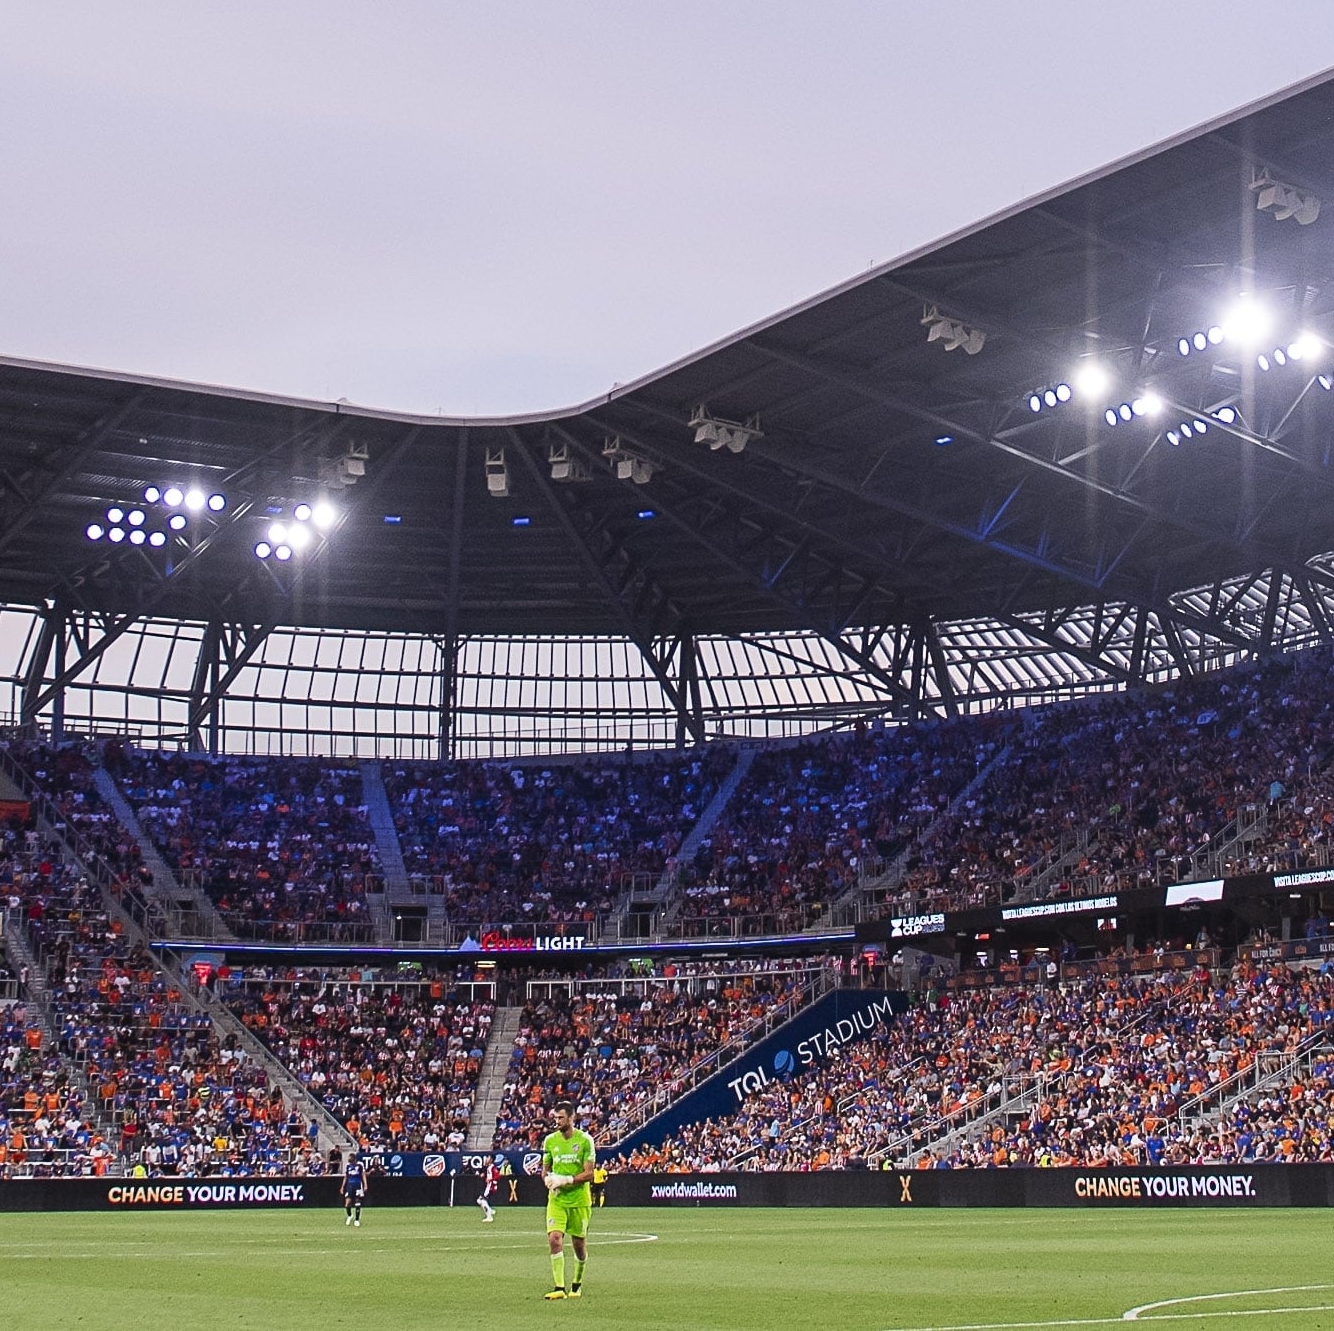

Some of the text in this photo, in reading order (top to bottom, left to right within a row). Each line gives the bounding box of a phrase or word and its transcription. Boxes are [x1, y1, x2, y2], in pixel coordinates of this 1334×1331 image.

[903, 913, 945, 927] LEAGUES
[536, 936, 585, 951] LIGHT
[728, 996, 893, 1102] TQL STADIUM
[108, 1184, 304, 1203] CHANGE YOUR MONEY.
[652, 1182, 737, 1198] xworldwallet.com
[1075, 1175, 1256, 1198] CHANGE YOUR MONEY.
